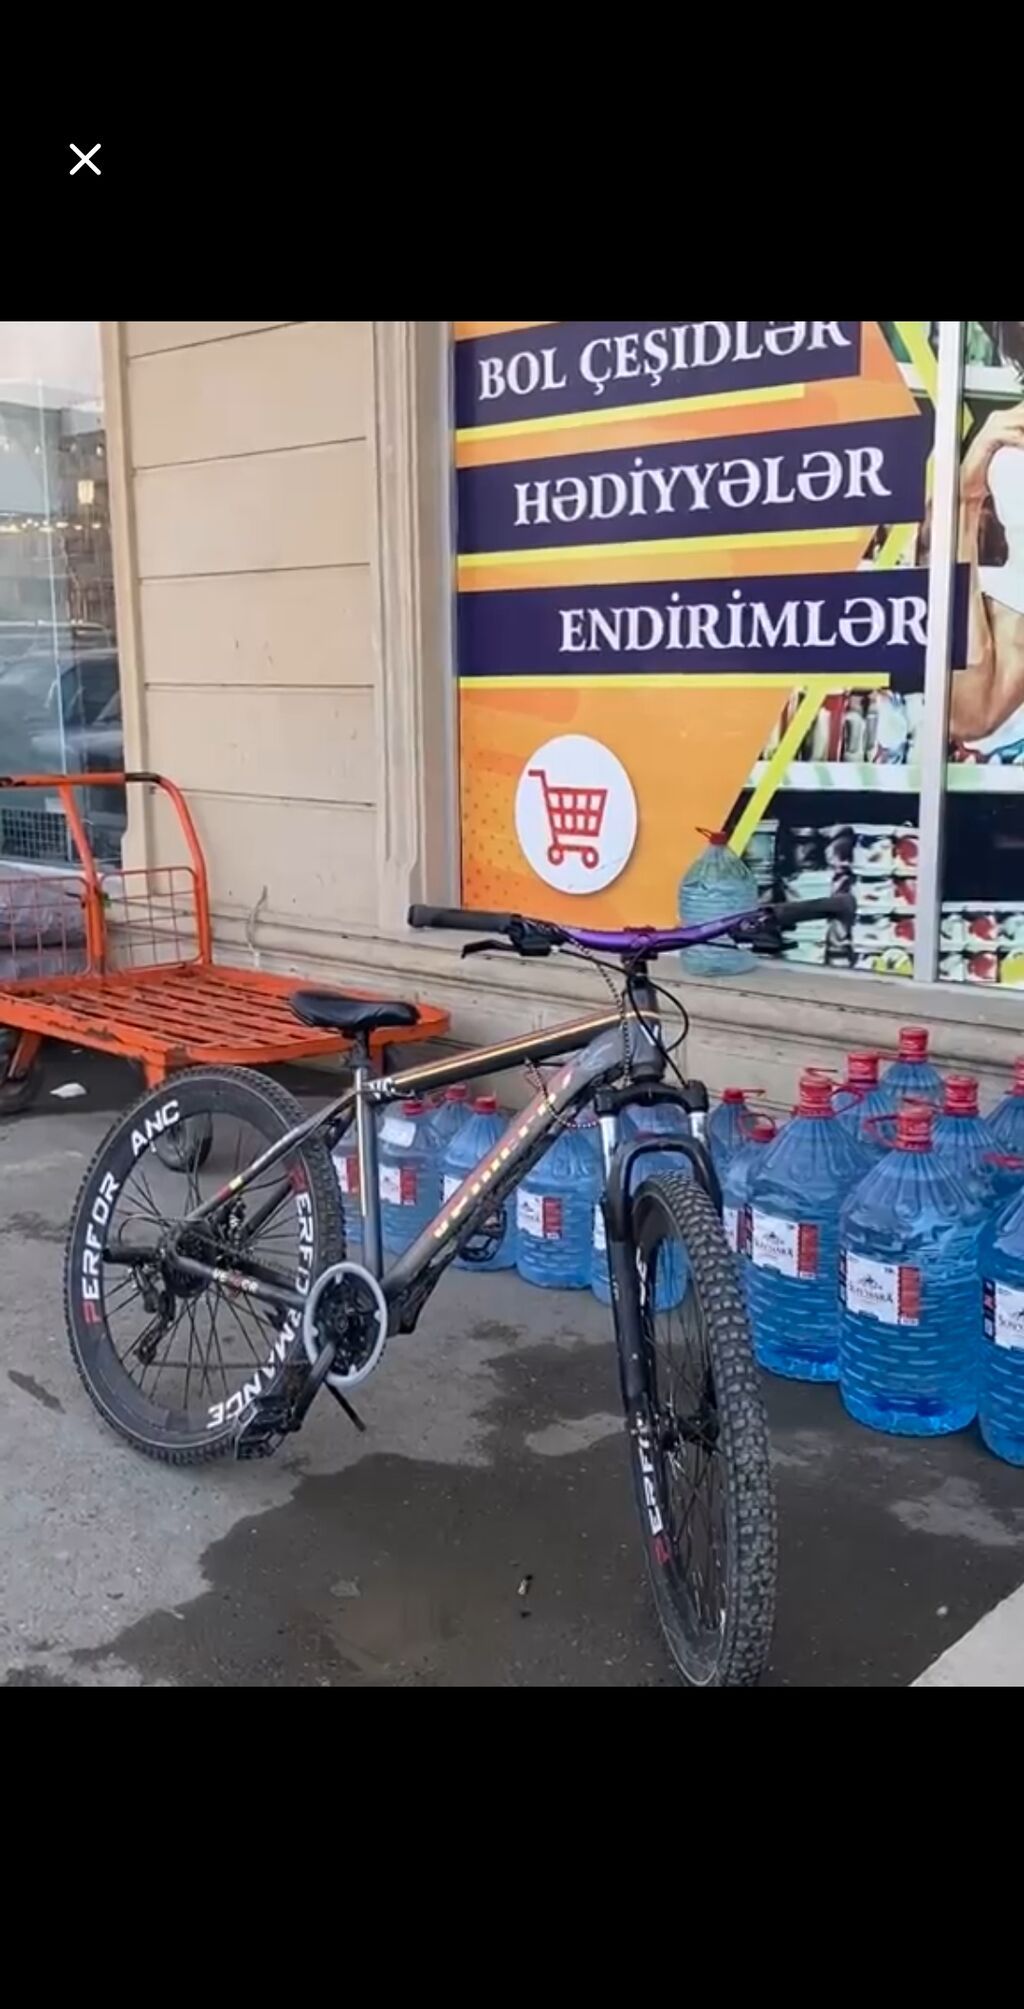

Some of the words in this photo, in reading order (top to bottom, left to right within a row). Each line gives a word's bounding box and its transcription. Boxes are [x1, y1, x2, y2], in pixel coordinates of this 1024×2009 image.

[479, 347, 566, 400] BOL
[513, 446, 892, 526] HƏDİYYƏLƏR
[558, 589, 929, 653] ENDİRİMLƏR
